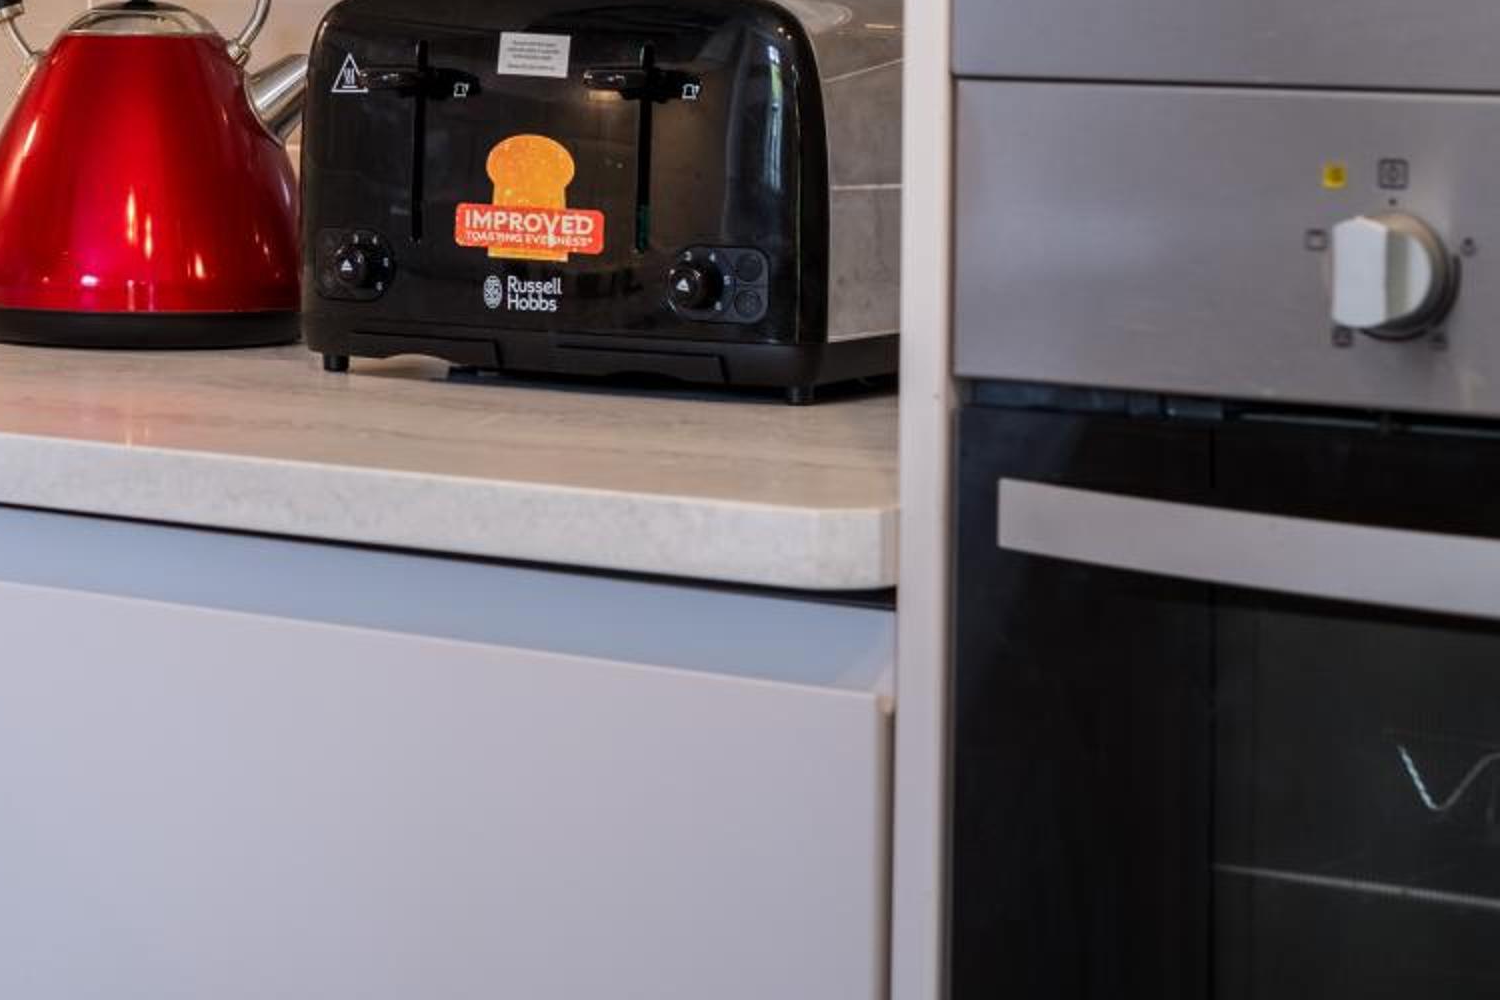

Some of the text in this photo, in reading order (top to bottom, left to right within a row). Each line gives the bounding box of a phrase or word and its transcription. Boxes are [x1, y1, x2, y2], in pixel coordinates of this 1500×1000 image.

[464, 208, 595, 236] IMPROVED
[466, 231, 522, 244] TOASTING
[507, 275, 563, 295] Russell
[507, 293, 558, 313] Hobbs
